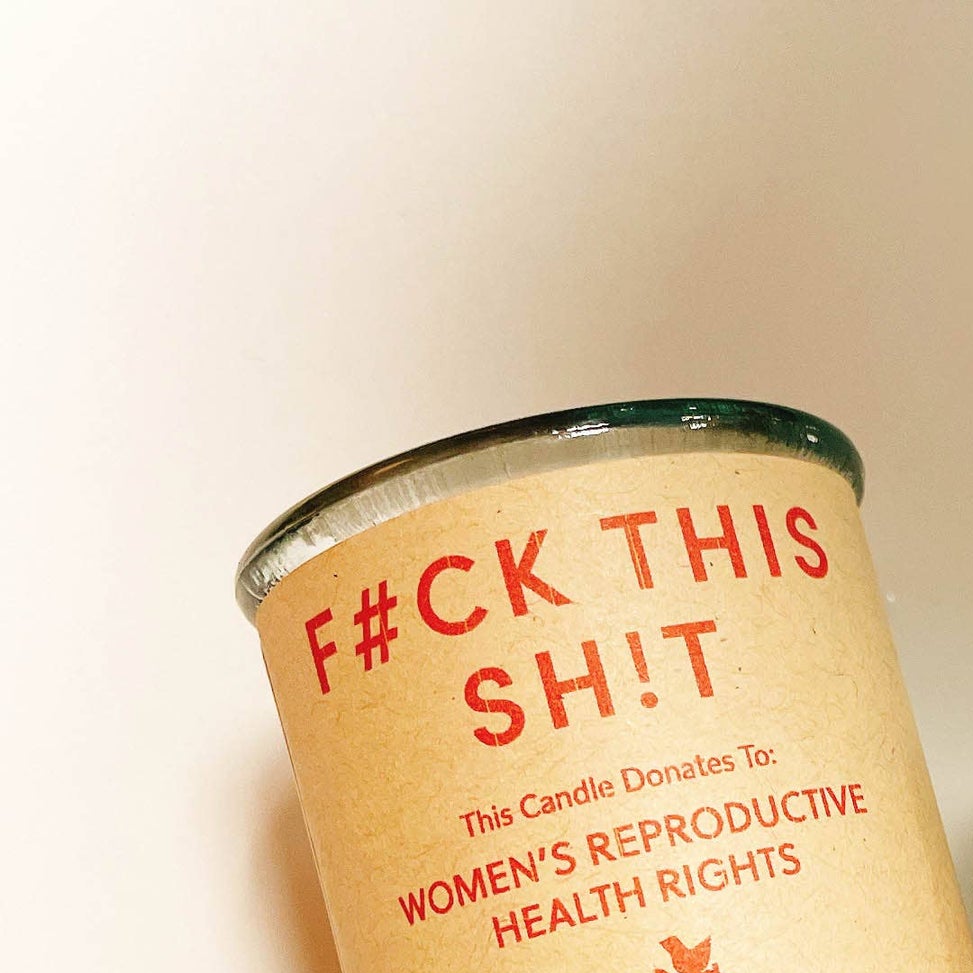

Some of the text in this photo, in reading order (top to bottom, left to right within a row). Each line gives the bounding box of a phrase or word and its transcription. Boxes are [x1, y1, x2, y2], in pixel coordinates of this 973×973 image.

[305, 504, 829, 695] F#CK THIS
[464, 620, 717, 747] SH!T
[459, 744, 777, 838] This Candle Donates To:
[398, 784, 868, 926] WOMEN'S REPRODUCTIVE
[491, 843, 801, 948] HEALTH RIGHTS
